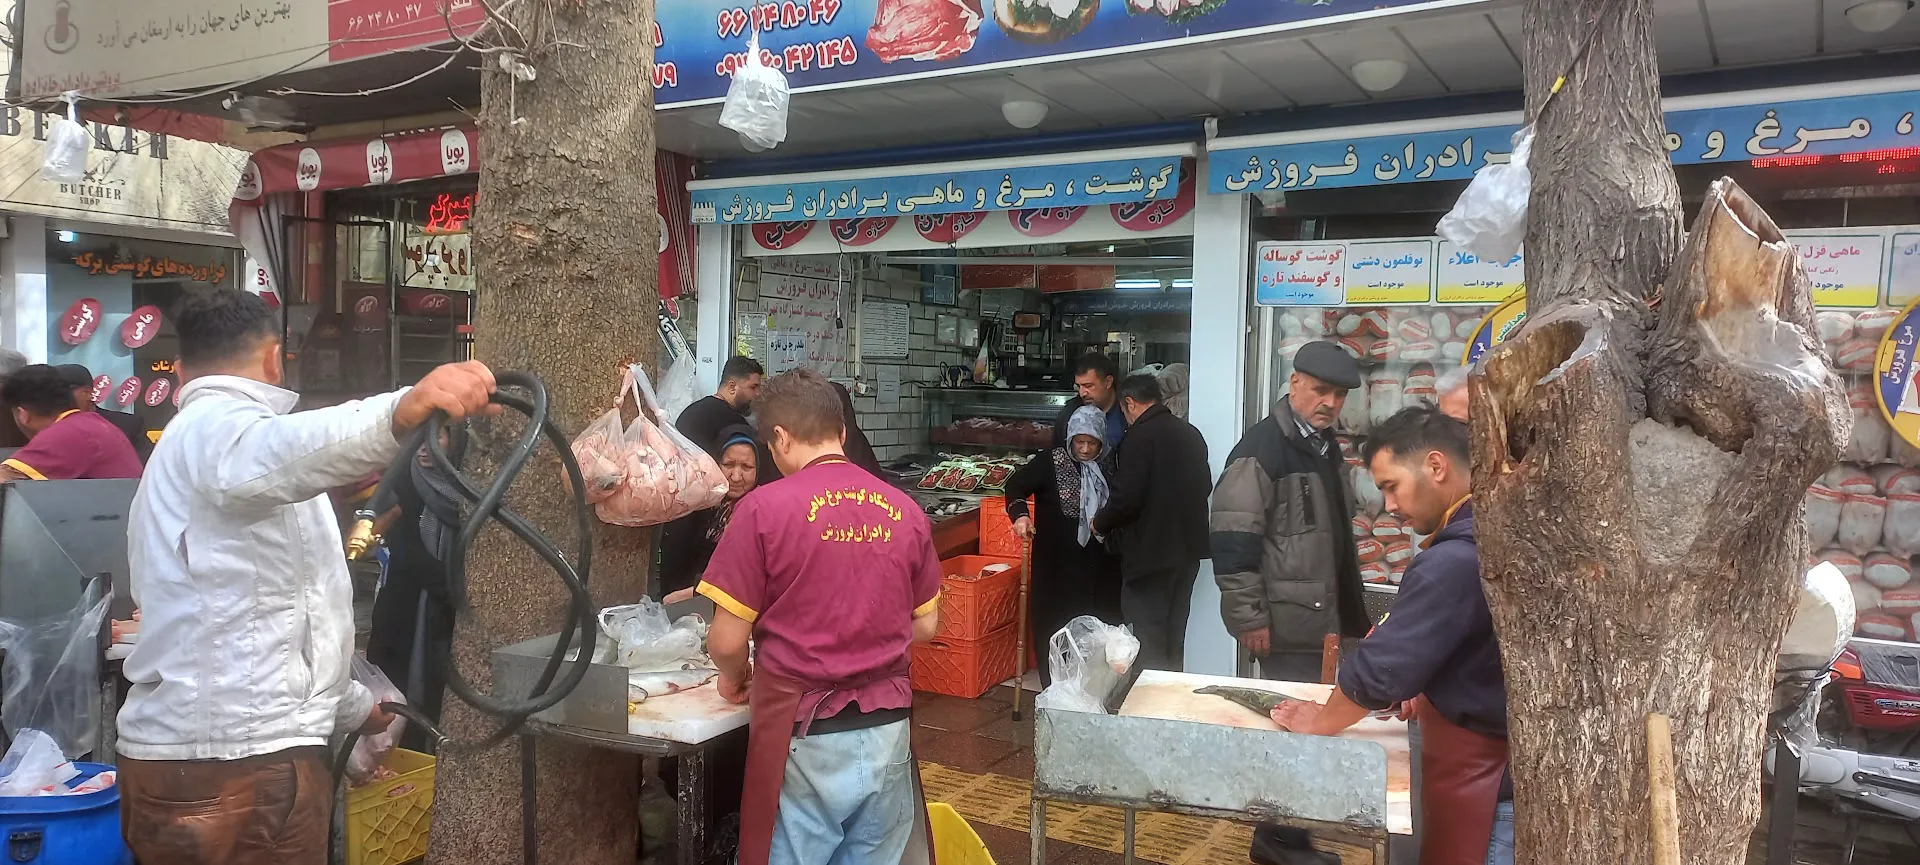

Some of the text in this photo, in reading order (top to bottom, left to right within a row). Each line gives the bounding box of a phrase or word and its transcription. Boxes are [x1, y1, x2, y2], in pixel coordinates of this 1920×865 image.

[187, 14, 197, 35] را
[199, 10, 225, 34] جهان
[229, 3, 251, 31] های
[718, 8, 748, 38] ۶۶
[780, 1, 806, 28] ۸۰
[123, 31, 138, 48] می
[141, 16, 172, 43] ارمغان
[175, 22, 185, 38] به
[785, 44, 815, 73] ۴۲
[817, 36, 857, 68] ۱۴۵
[1746, 109, 1871, 156] مرغ
[446, 145, 464, 165] پویا
[1700, 131, 1725, 159] و
[301, 162, 318, 179] پویا
[1225, 144, 1359, 191] فروزش
[1373, 136, 1511, 182] رادران
[60, 183, 121, 200] BUTCHER
[997, 173, 1055, 208] مرغ
[1084, 165, 1174, 199] گوشت
[721, 188, 794, 222] فروزش
[802, 186, 888, 217] برادران
[896, 180, 965, 213] ماهی
[973, 186, 987, 209] و
[1148, 201, 1175, 224] تازه
[1264, 248, 1342, 266] گوشت گوساله
[1352, 253, 1423, 270] بوقلمون دشتی
[1804, 245, 1827, 258] قزل
[1829, 245, 1860, 258] ماهی
[1262, 271, 1341, 288] و گوسفند تازه
[1383, 281, 1404, 289] موجود
[1815, 281, 1844, 291] موجود
[69, 303, 94, 337] گوشت
[132, 313, 154, 341] ماهی
[806, 485, 903, 523] فروشگاه گوشت مرغ ماهی
[821, 521, 891, 543] برادران فروزش
